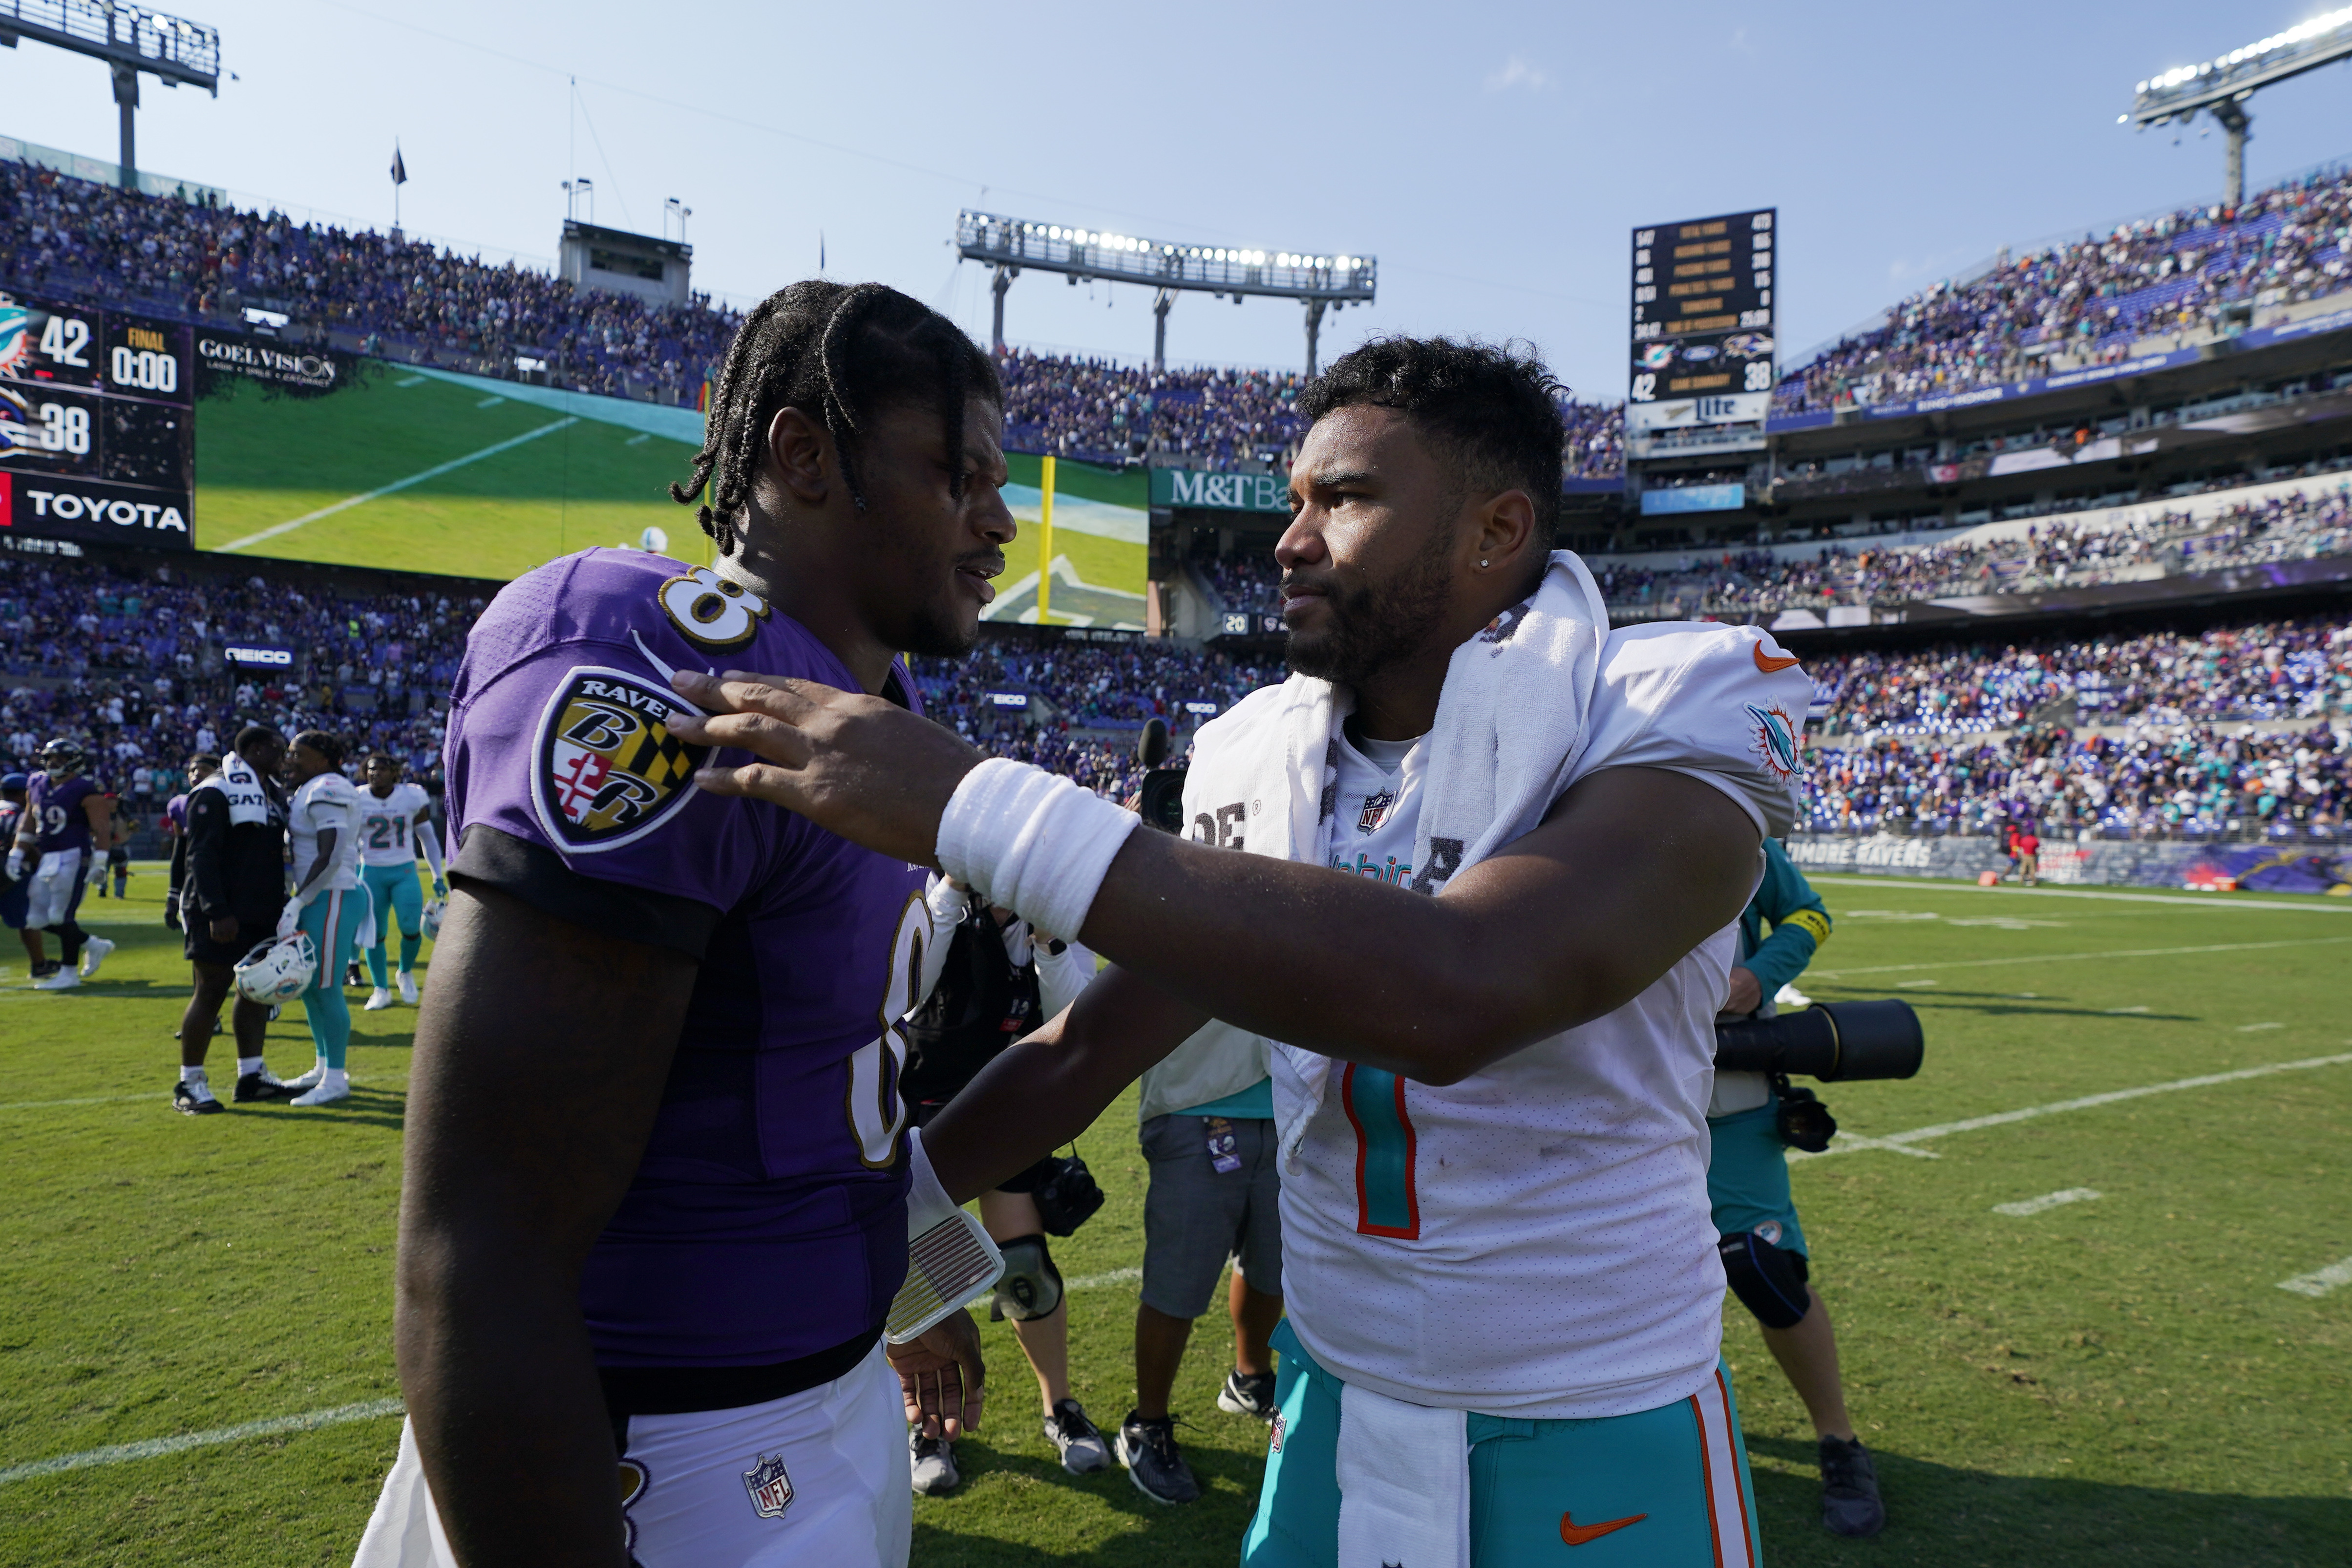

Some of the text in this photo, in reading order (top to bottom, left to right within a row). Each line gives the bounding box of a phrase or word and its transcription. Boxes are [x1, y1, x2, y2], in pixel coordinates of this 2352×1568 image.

[39, 316, 89, 368] 42
[127, 326, 166, 352] FINAL
[111, 346, 177, 393] 0:00
[199, 339, 336, 378] GOEL VISION
[1631, 373, 1657, 402] 42
[1744, 361, 1771, 391] 38
[39, 403, 90, 454] 38
[1170, 470, 1253, 508] M&T
[26, 489, 187, 532] TOYOTA
[658, 564, 772, 655] 8
[1226, 615, 1245, 632] 20
[225, 647, 292, 664] GEICO
[986, 693, 1027, 706] EICO
[1361, 807, 1386, 826] NFL
[367, 814, 405, 850] 21
[1785, 841, 1851, 865] TIMORE
[757, 1479, 791, 1509] NFL
